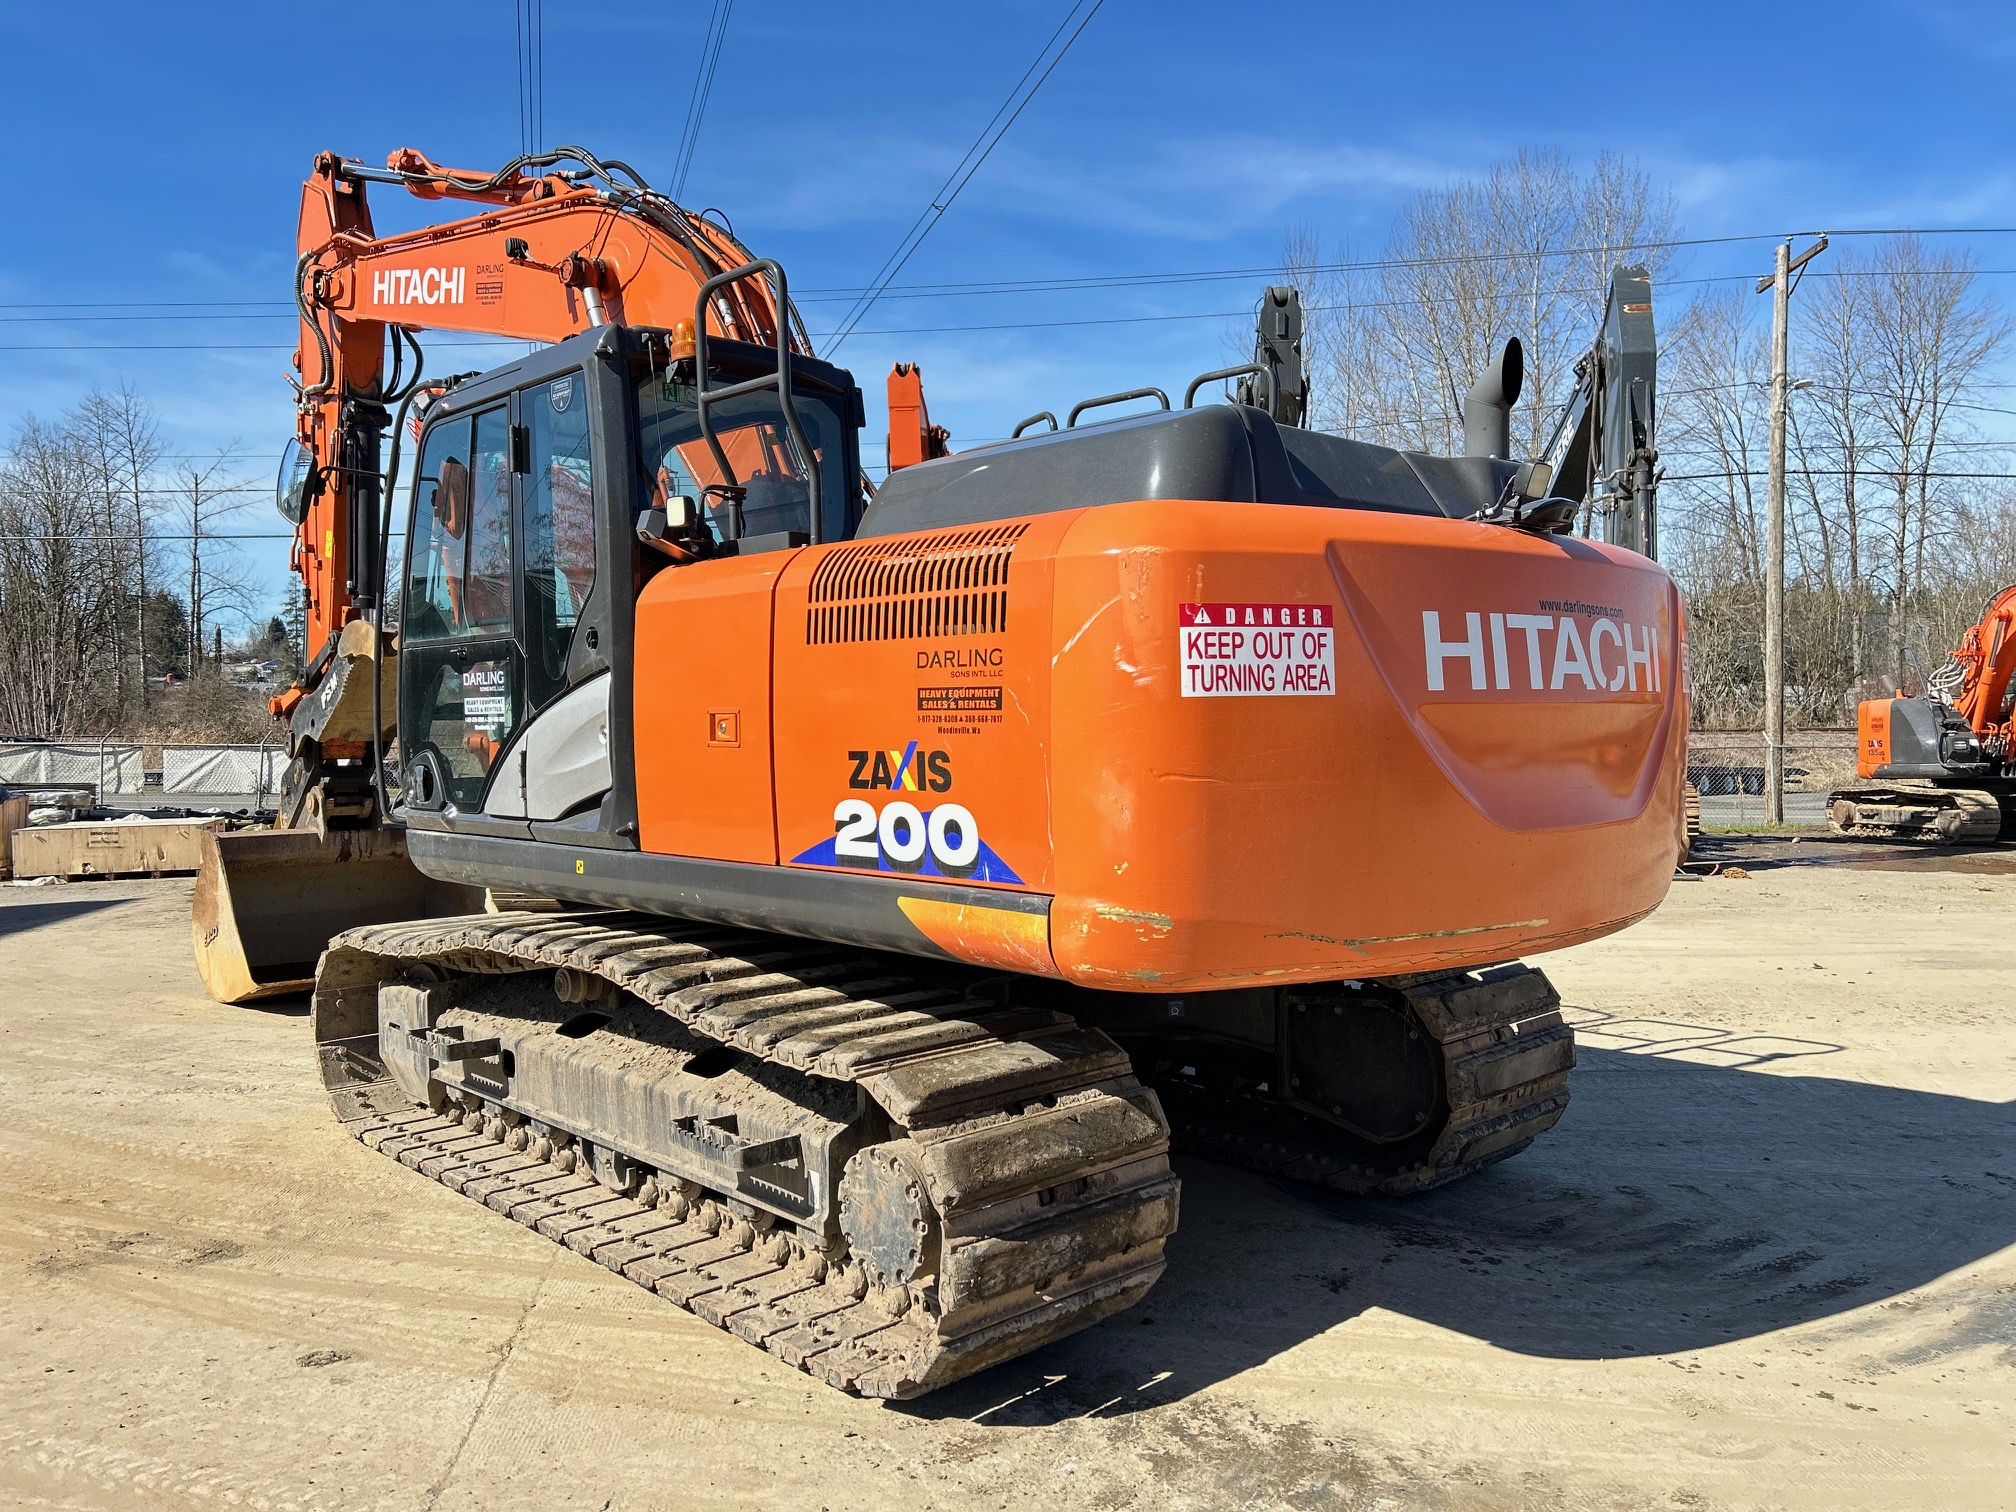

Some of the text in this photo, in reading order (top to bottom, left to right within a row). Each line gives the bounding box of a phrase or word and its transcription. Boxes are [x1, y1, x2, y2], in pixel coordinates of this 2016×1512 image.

[476, 264, 504, 274] DARLING
[373, 267, 465, 305] HITACHI
[1547, 414, 1574, 481] EERE
[1225, 607, 1322, 626] DANGER
[1539, 599, 1624, 618] www.darlingsons.com
[1188, 632, 1328, 659] KEEP OUT OF
[1422, 611, 1661, 693] HITACHI
[917, 648, 1003, 669] DARLING
[463, 671, 505, 686] DARLING
[1187, 664, 1331, 692] TURNING AREA
[920, 689, 1000, 698] HEAVY EQUIPMENT
[922, 700, 997, 709] SALES & RENTALS
[848, 740, 952, 793] ZAXIS
[833, 799, 979, 873] 200
